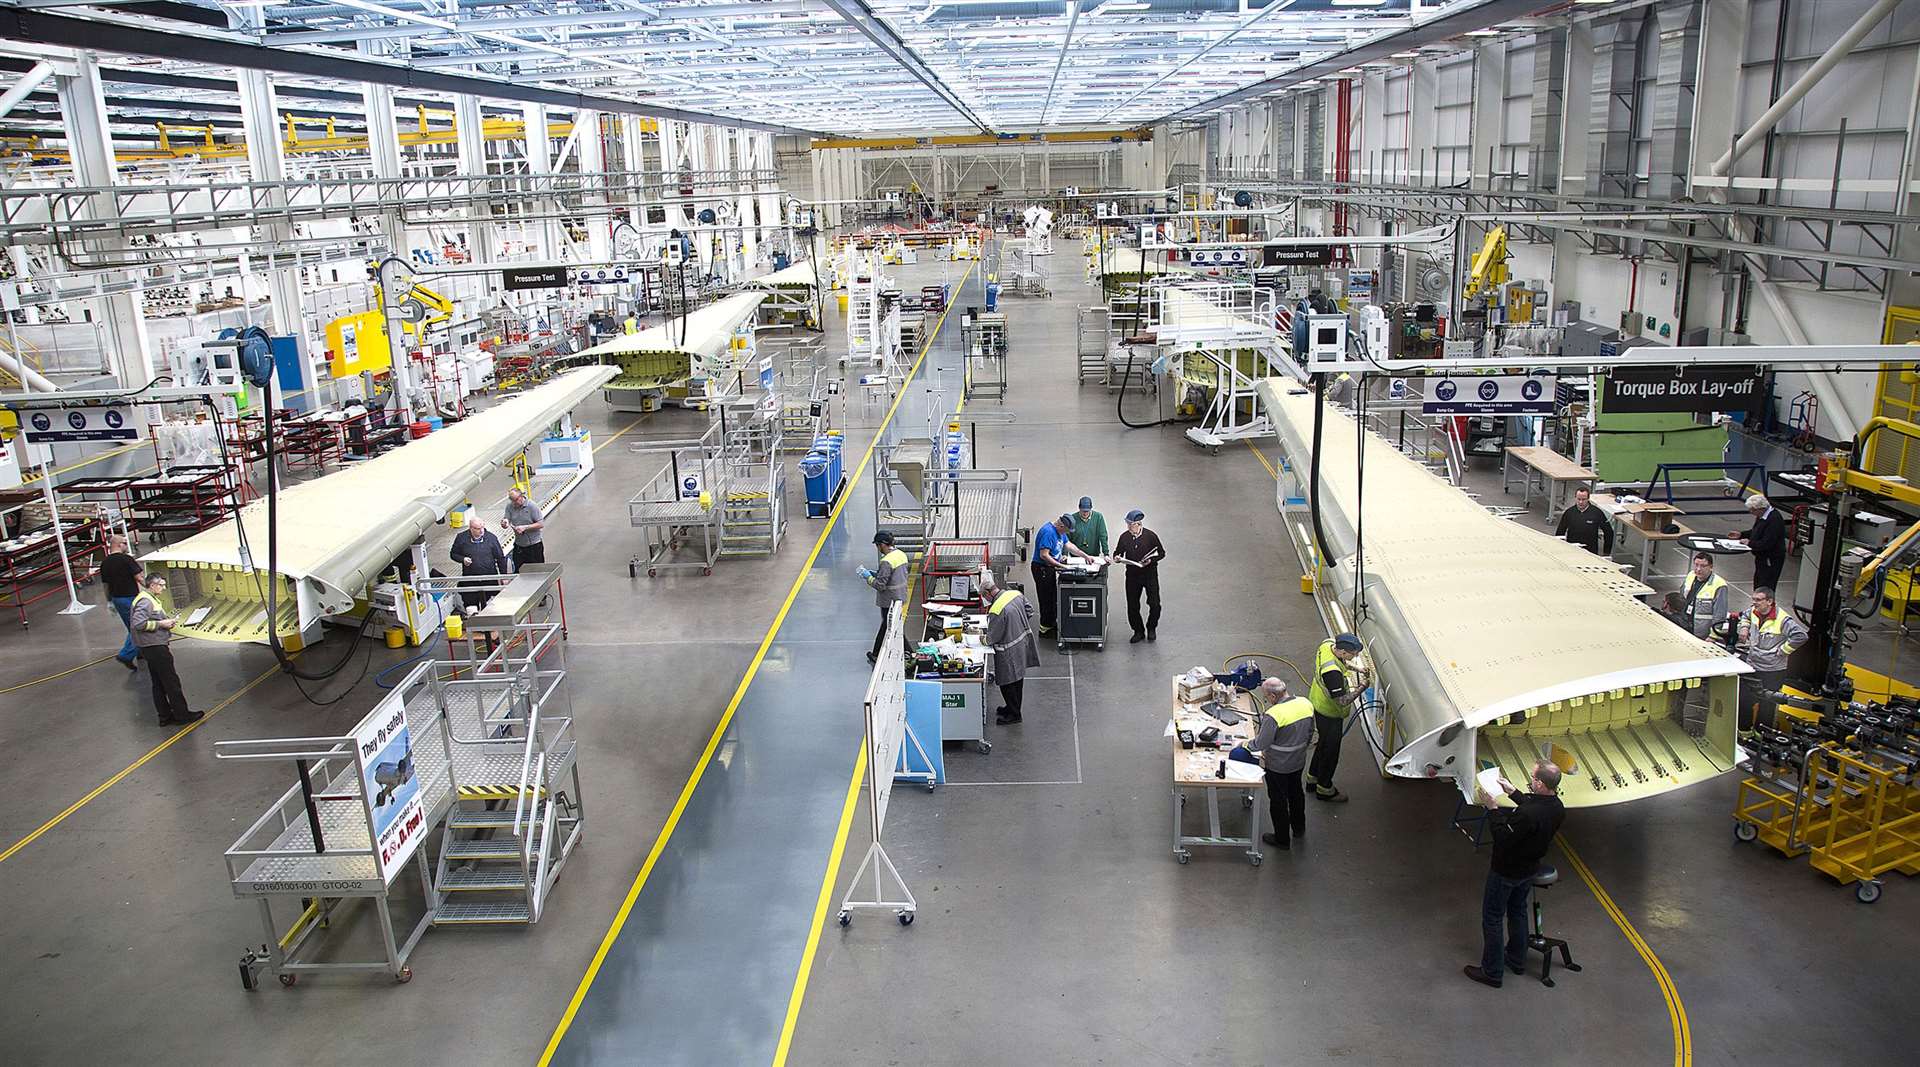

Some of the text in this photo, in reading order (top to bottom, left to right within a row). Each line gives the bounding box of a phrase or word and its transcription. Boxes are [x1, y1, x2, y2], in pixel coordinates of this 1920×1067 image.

[1276, 251, 1303, 259] Pressure
[514, 273, 556, 283] Pressure Test
[1614, 378, 1755, 398] Torque Box Lay-off
[362, 710, 404, 759] They fly safely
[380, 829, 391, 846] when
[391, 820, 399, 834] you
[399, 807, 410, 823] make
[252, 882, 317, 891] C01601001-001
